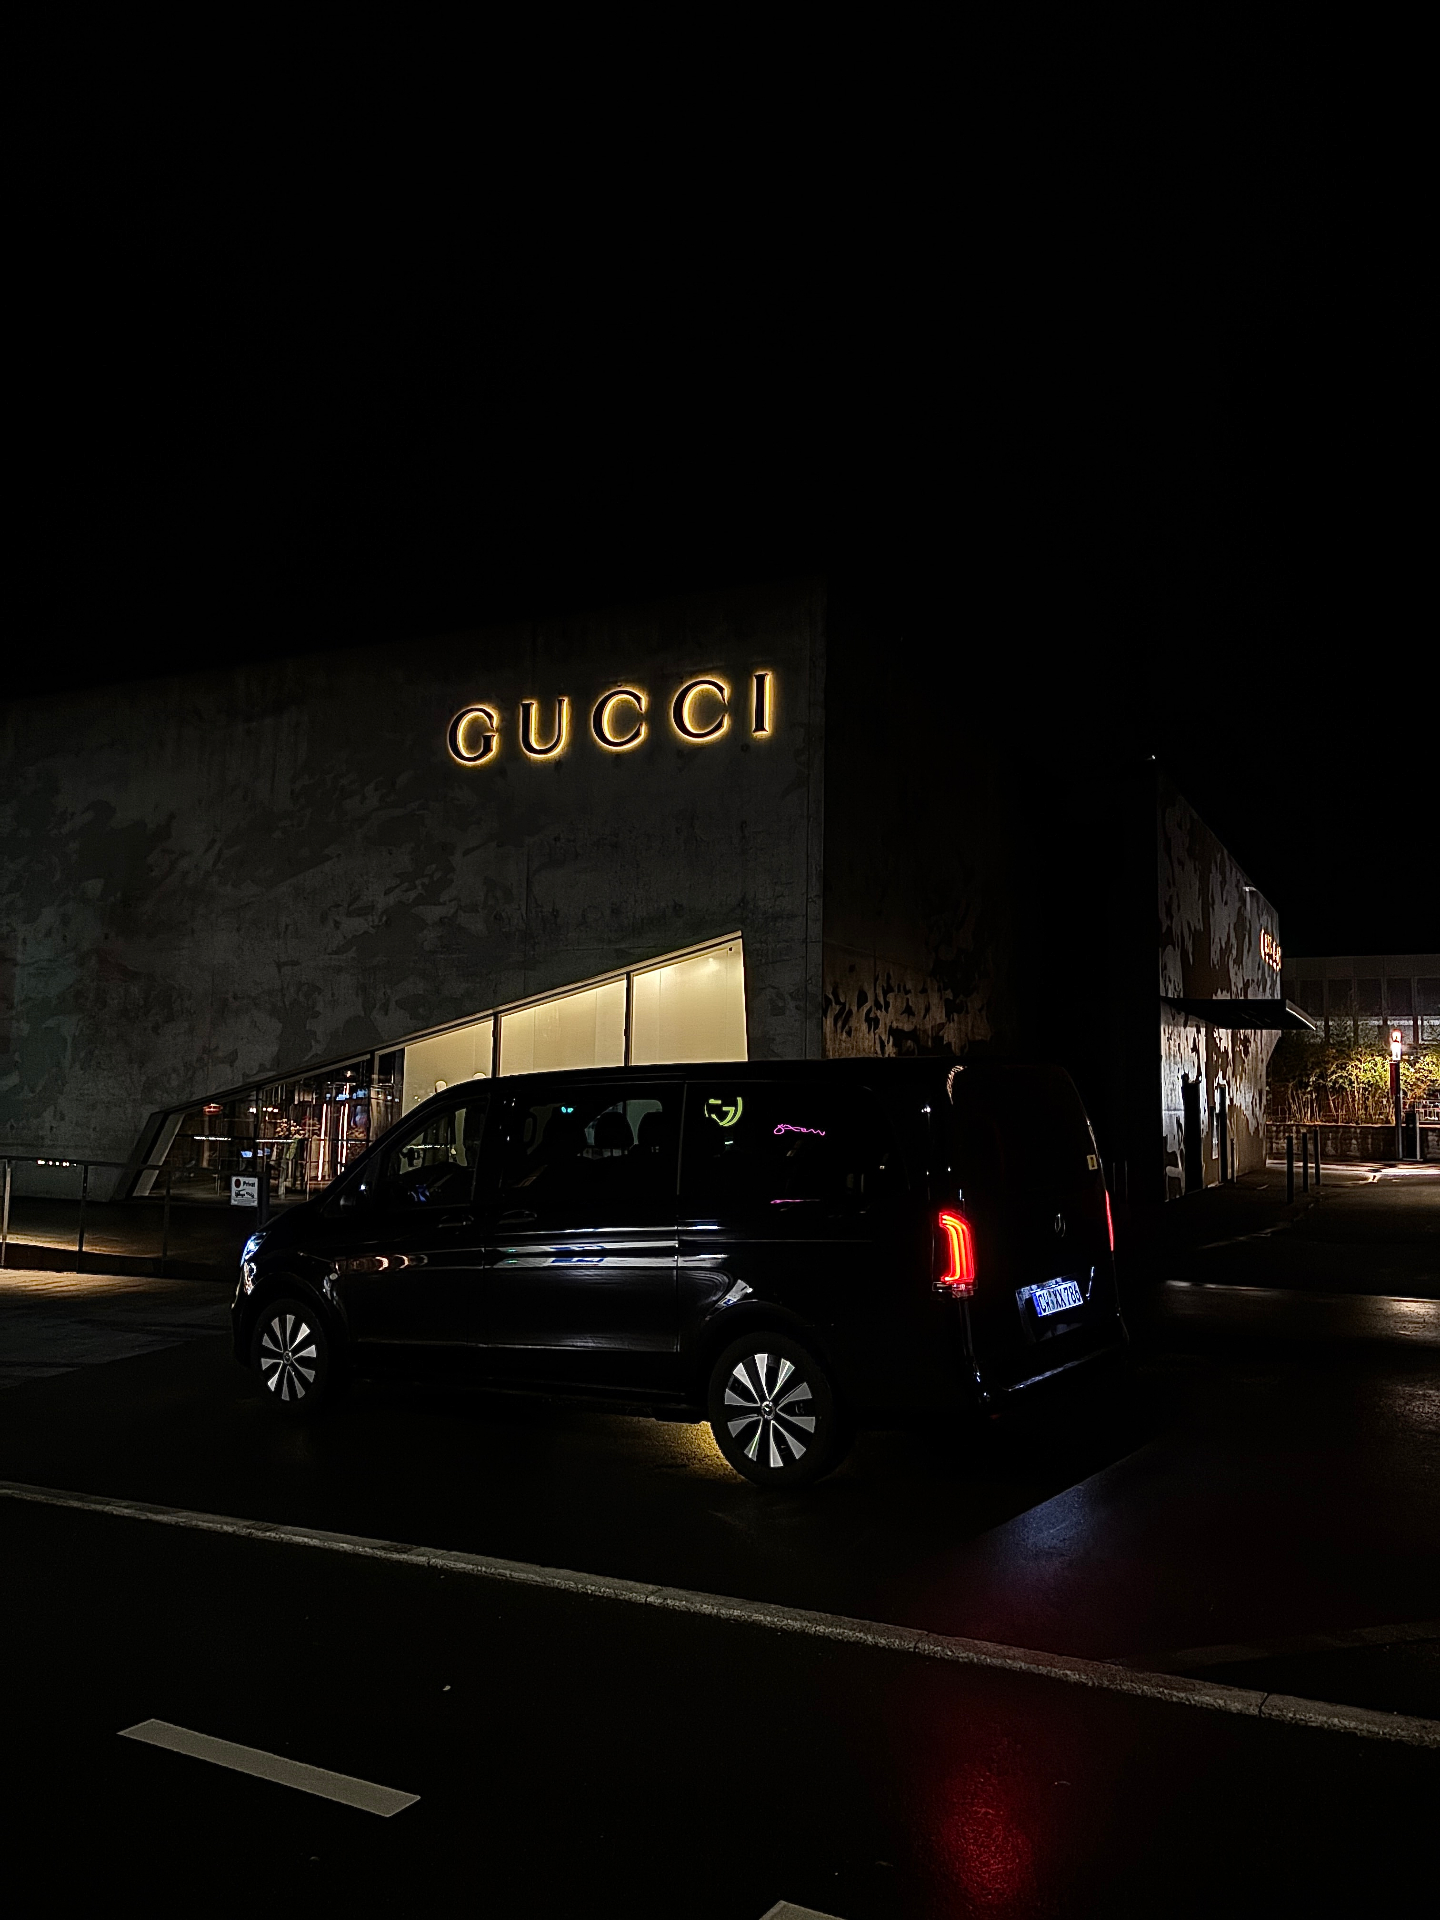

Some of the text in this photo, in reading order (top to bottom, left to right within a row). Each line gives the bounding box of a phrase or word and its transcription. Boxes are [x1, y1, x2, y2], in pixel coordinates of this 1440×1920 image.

[447, 671, 772, 765] GUCCI
[242, 1180, 256, 1188] Privat
[1063, 1284, 1081, 1305] 786
